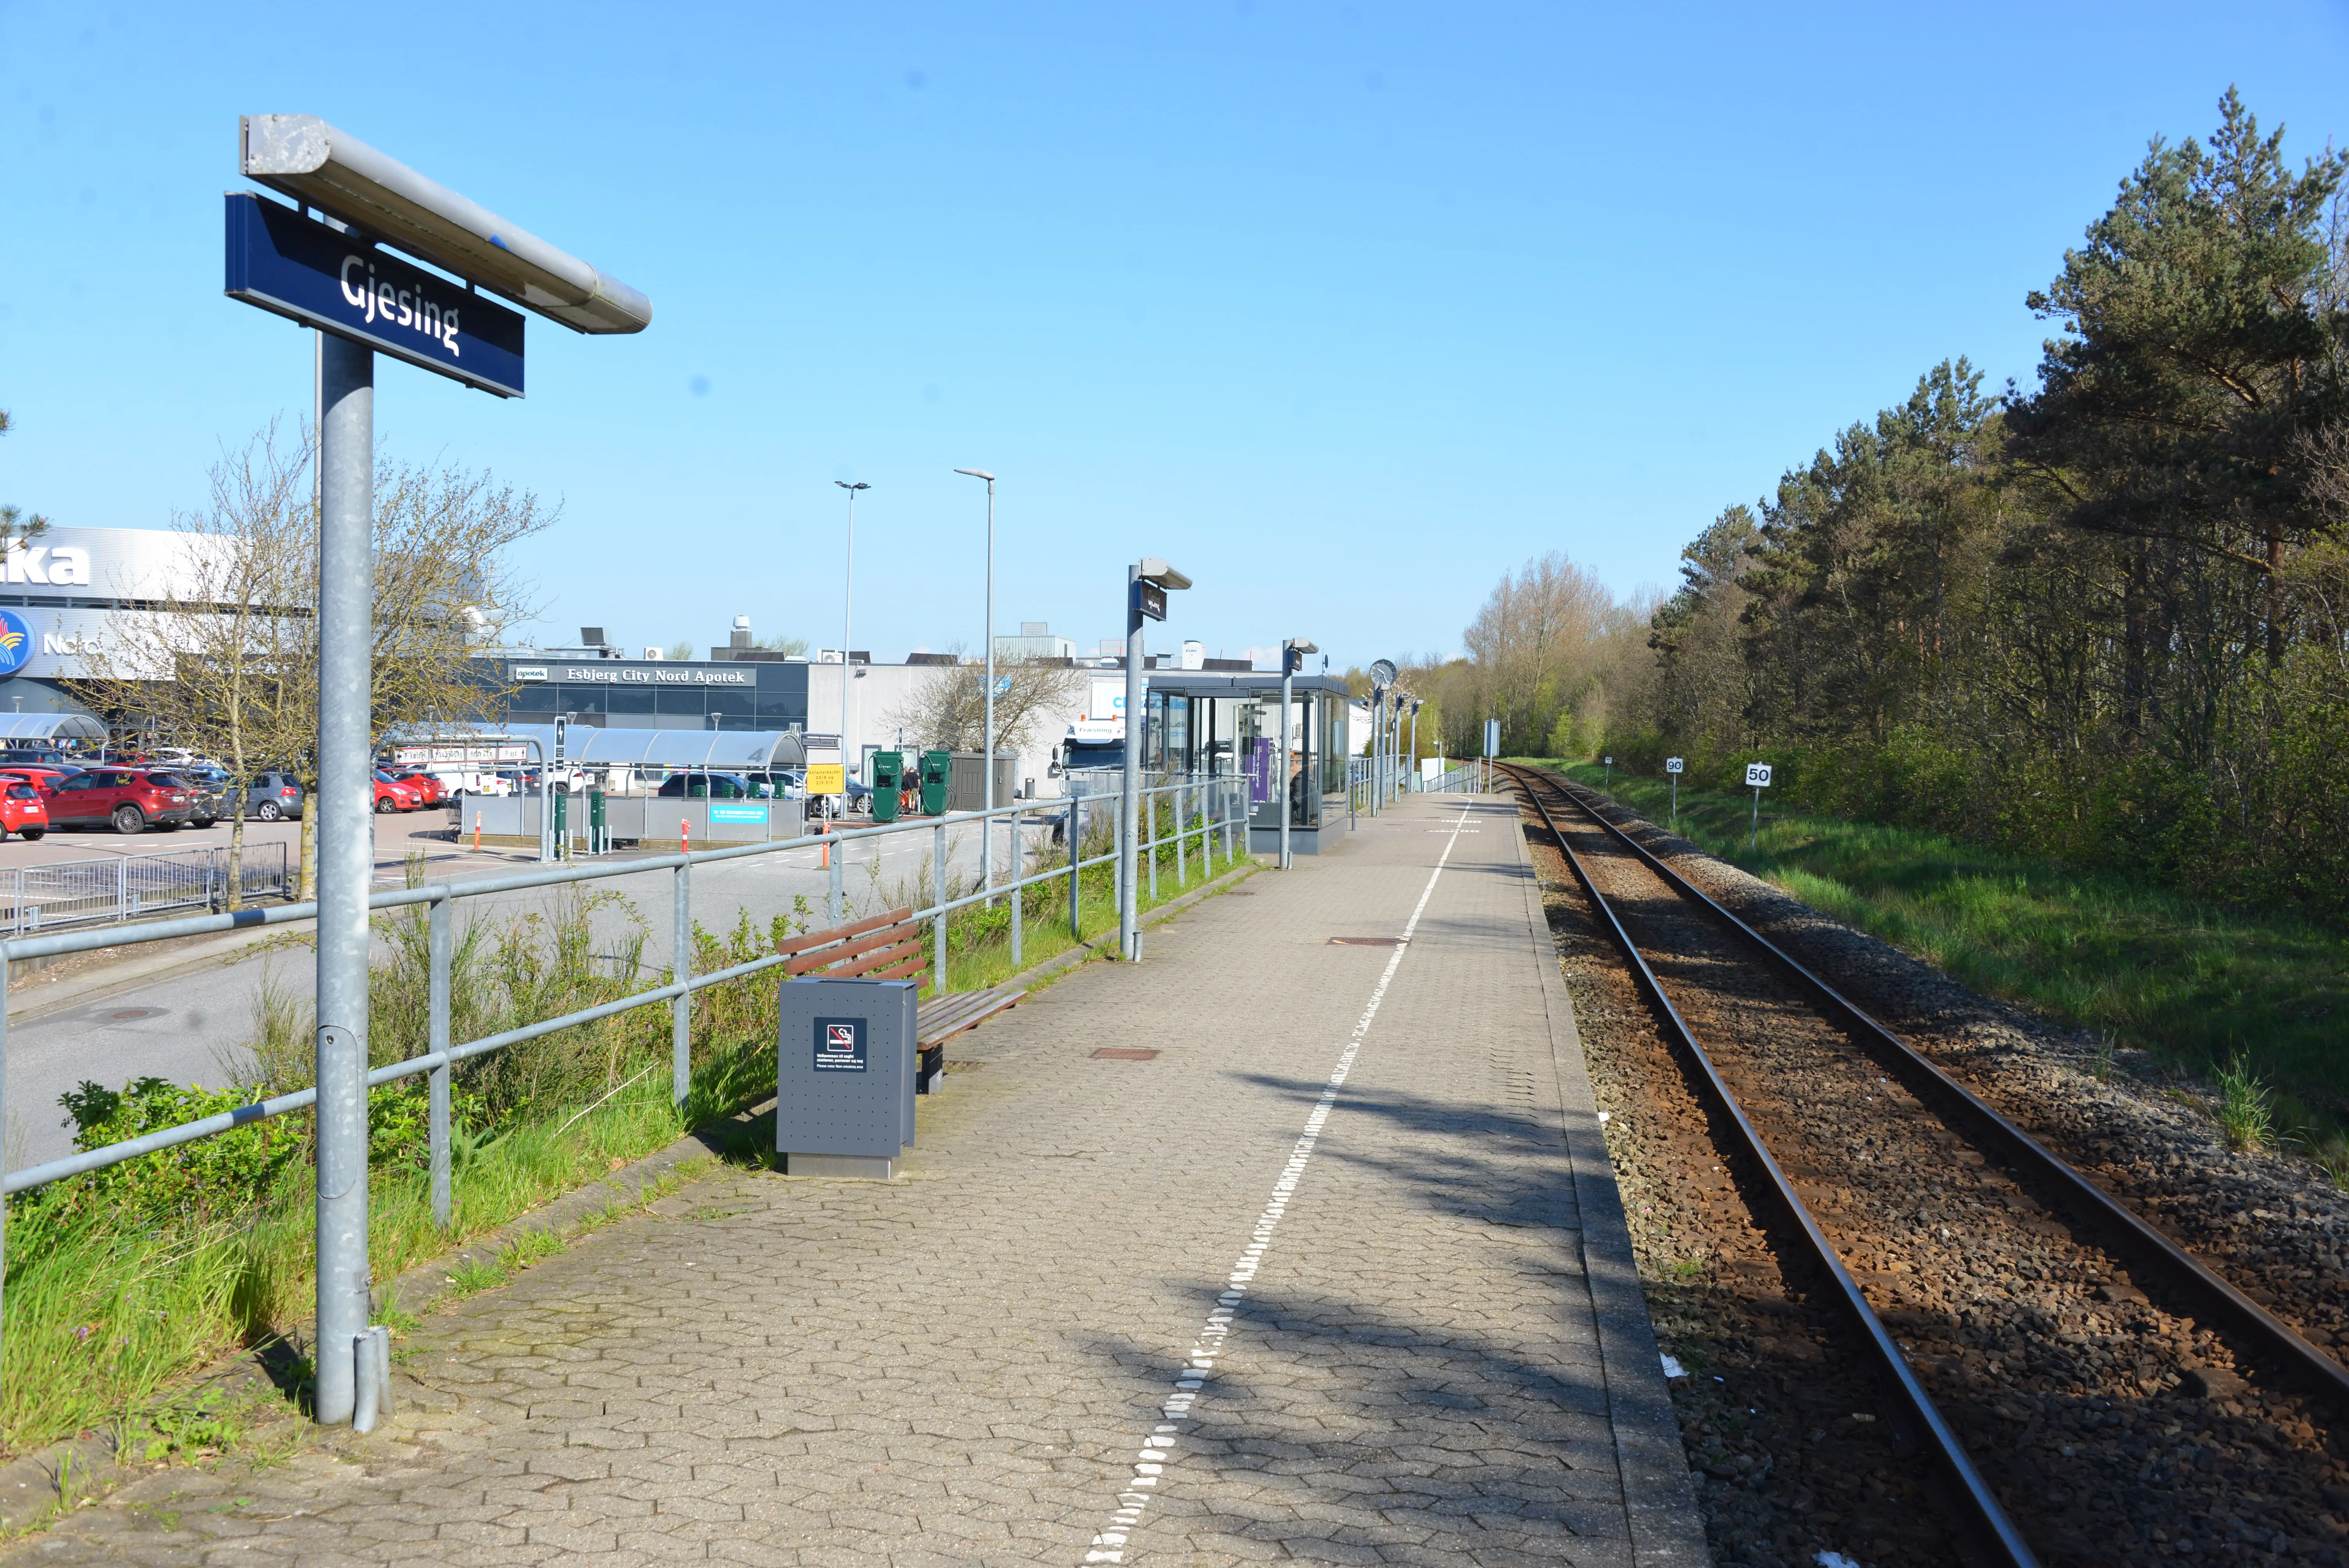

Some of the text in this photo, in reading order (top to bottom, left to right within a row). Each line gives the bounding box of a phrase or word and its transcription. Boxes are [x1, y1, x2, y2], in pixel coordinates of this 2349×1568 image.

[341, 255, 459, 357] Gjesing
[0, 537, 89, 584] ka
[567, 668, 745, 685] Esbjerg City Nord Apotek
[747, 748, 764, 762] 4
[1668, 761, 1681, 770] 90
[1748, 768, 1769, 782] 50
